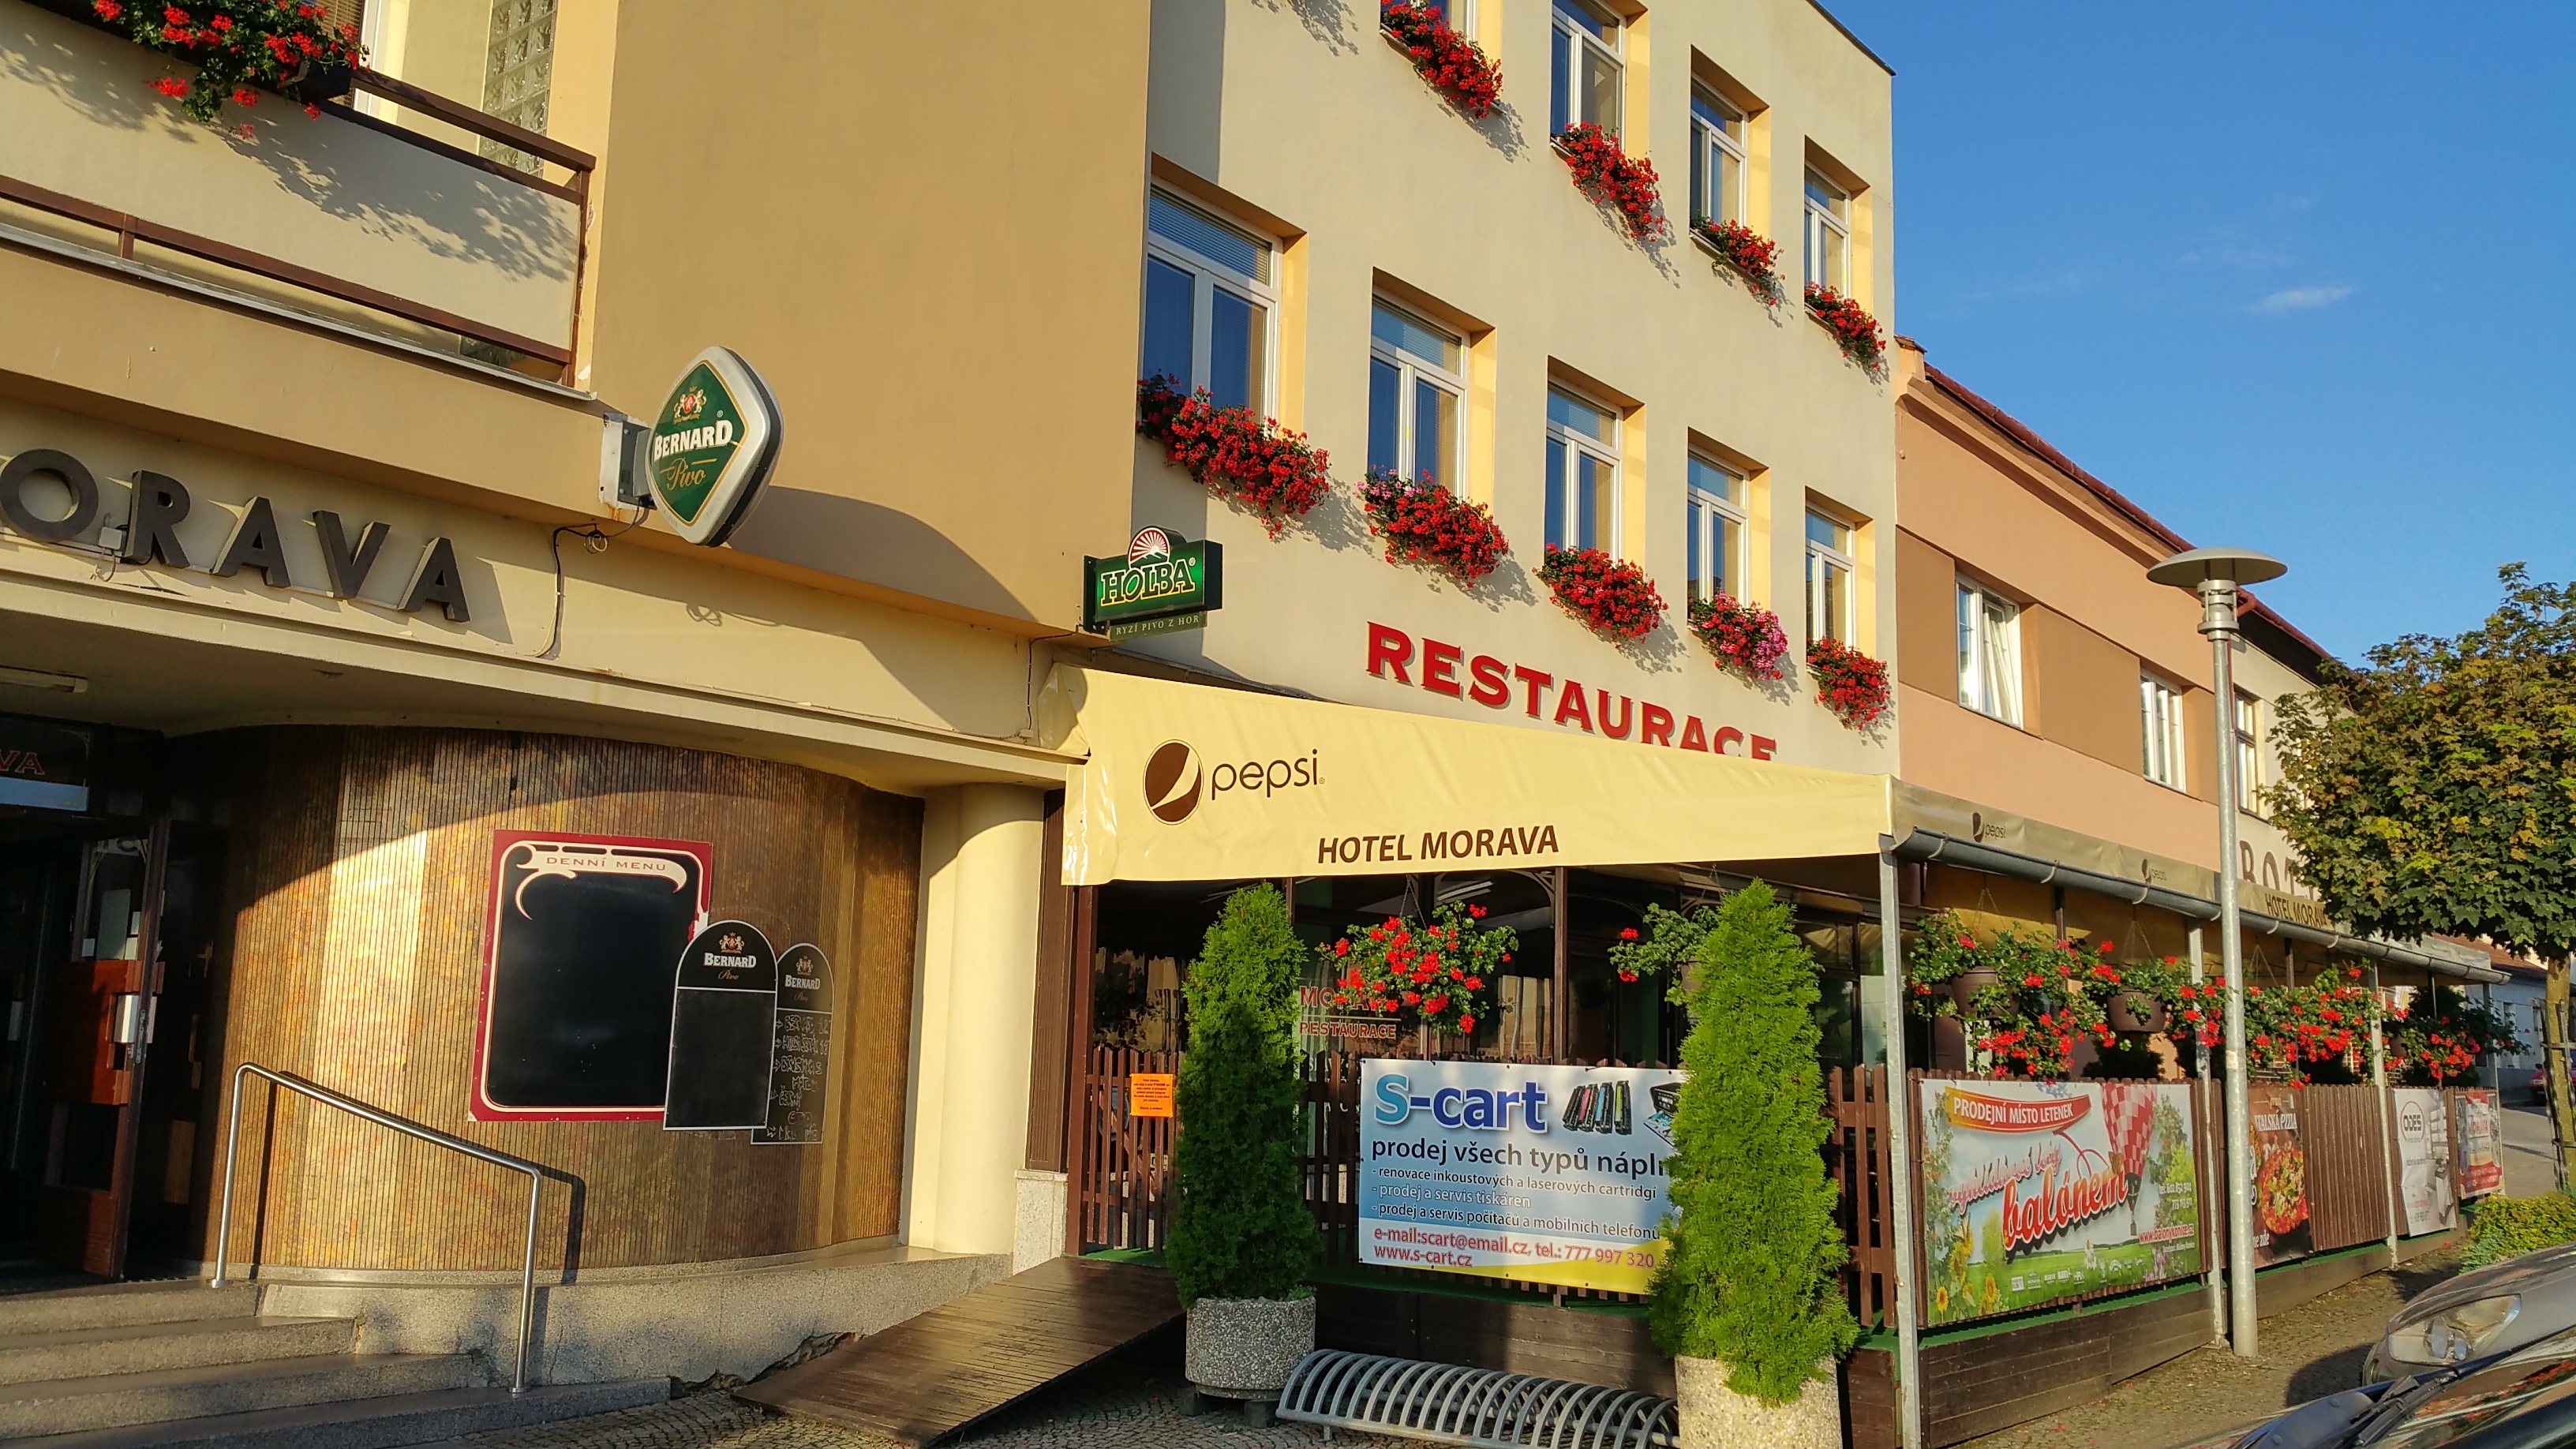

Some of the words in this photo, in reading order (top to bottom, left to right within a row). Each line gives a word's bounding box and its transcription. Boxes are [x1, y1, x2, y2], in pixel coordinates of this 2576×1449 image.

[653, 420, 733, 461] BERNARD
[667, 457, 706, 491] Pivo
[1101, 559, 1196, 606] HOLBA
[1116, 622, 1138, 635] RYZÍ
[1141, 620, 1165, 631] PIVO
[1169, 619, 1174, 627] Z
[1178, 615, 1200, 625] HOR
[1366, 620, 1779, 760] RESTAURACE
[1211, 748, 1318, 800] pepsi
[1318, 833, 1413, 864] HOTEL
[1421, 825, 1559, 859] MORAVA
[1985, 823, 2006, 840] pepsi
[546, 857, 607, 867] DENNÍ
[616, 861, 667, 871] MENU
[2265, 893, 2294, 920] HOTEL
[703, 953, 757, 969] BERNARD
[717, 969, 739, 981] Pivo
[784, 975, 821, 990] BERNARD
[1300, 1020, 1397, 1039] RESTAURACE
[1374, 1073, 1547, 1133] S-cart
[1953, 1097, 2007, 1125] PRODEJNÍ
[2009, 1104, 2039, 1125] MÍSTO
[2040, 1103, 2074, 1123] LETENEK
[2280, 1113, 2297, 1130] PIZZA
[2403, 1114, 2422, 1132] ODES
[1372, 1138, 1447, 1166] prodej
[1454, 1141, 1522, 1166] všech
[1530, 1148, 1588, 1174] typů
[1379, 1167, 1431, 1180] renovace
[1433, 1170, 1513, 1189] inkoustových
[1517, 1178, 1524, 1188] a
[1527, 1176, 1595, 1195] laserových
[1599, 1185, 1657, 1201] cartridgí
[1380, 1184, 1421, 1201] prodej
[1424, 1189, 1432, 1200] a
[1435, 1189, 1473, 1204] servis
[1476, 1190, 1531, 1208] tiskáren
[1380, 1203, 1417, 1219] prodej
[1420, 1208, 1426, 1217] a
[1429, 1208, 1464, 1221] servis
[1467, 1210, 1519, 1226] počítačů
[1533, 1217, 1599, 1234] mobilních
[1603, 1222, 1661, 1240] telefonů
[2002, 1165, 2129, 1251] balónem
[1374, 1227, 1531, 1256] e-mail:scart@email.cz,
[1565, 1245, 1591, 1261] 777
[1595, 1249, 1623, 1264] 997
[1627, 1252, 1654, 1267] 320
[1374, 1245, 1473, 1267] www.s-cart.cz
